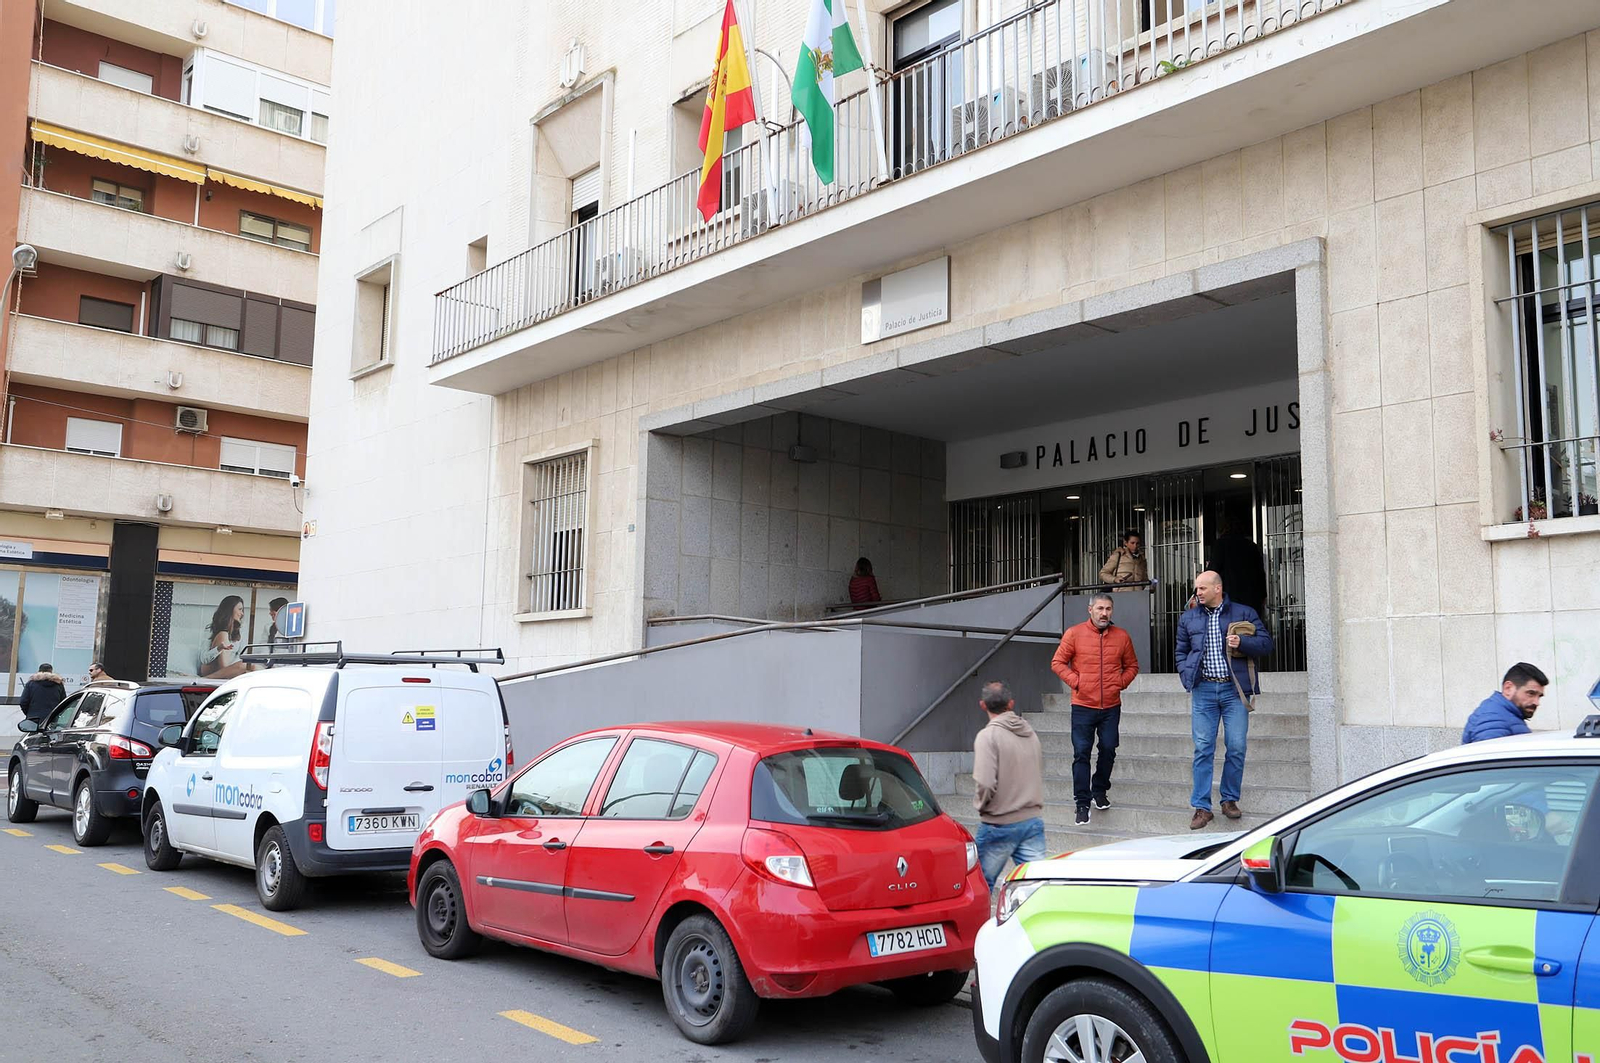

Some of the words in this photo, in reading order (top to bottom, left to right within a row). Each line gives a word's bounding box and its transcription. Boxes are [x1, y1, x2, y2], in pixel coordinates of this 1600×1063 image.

[885, 318, 907, 331] Palacio
[908, 315, 916, 324] de
[918, 307, 943, 322] Justicia
[1036, 427, 1147, 470] PALACIO
[1178, 417, 1210, 448] DE
[1245, 402, 1300, 437] JUS
[445, 768, 503, 784] moncobra
[215, 783, 263, 810] moncobra
[355, 817, 388, 830] 7360
[392, 815, 416, 828] KWN
[888, 882, 918, 890] CLIO
[878, 931, 915, 952] 7782
[916, 927, 942, 946] HCD
